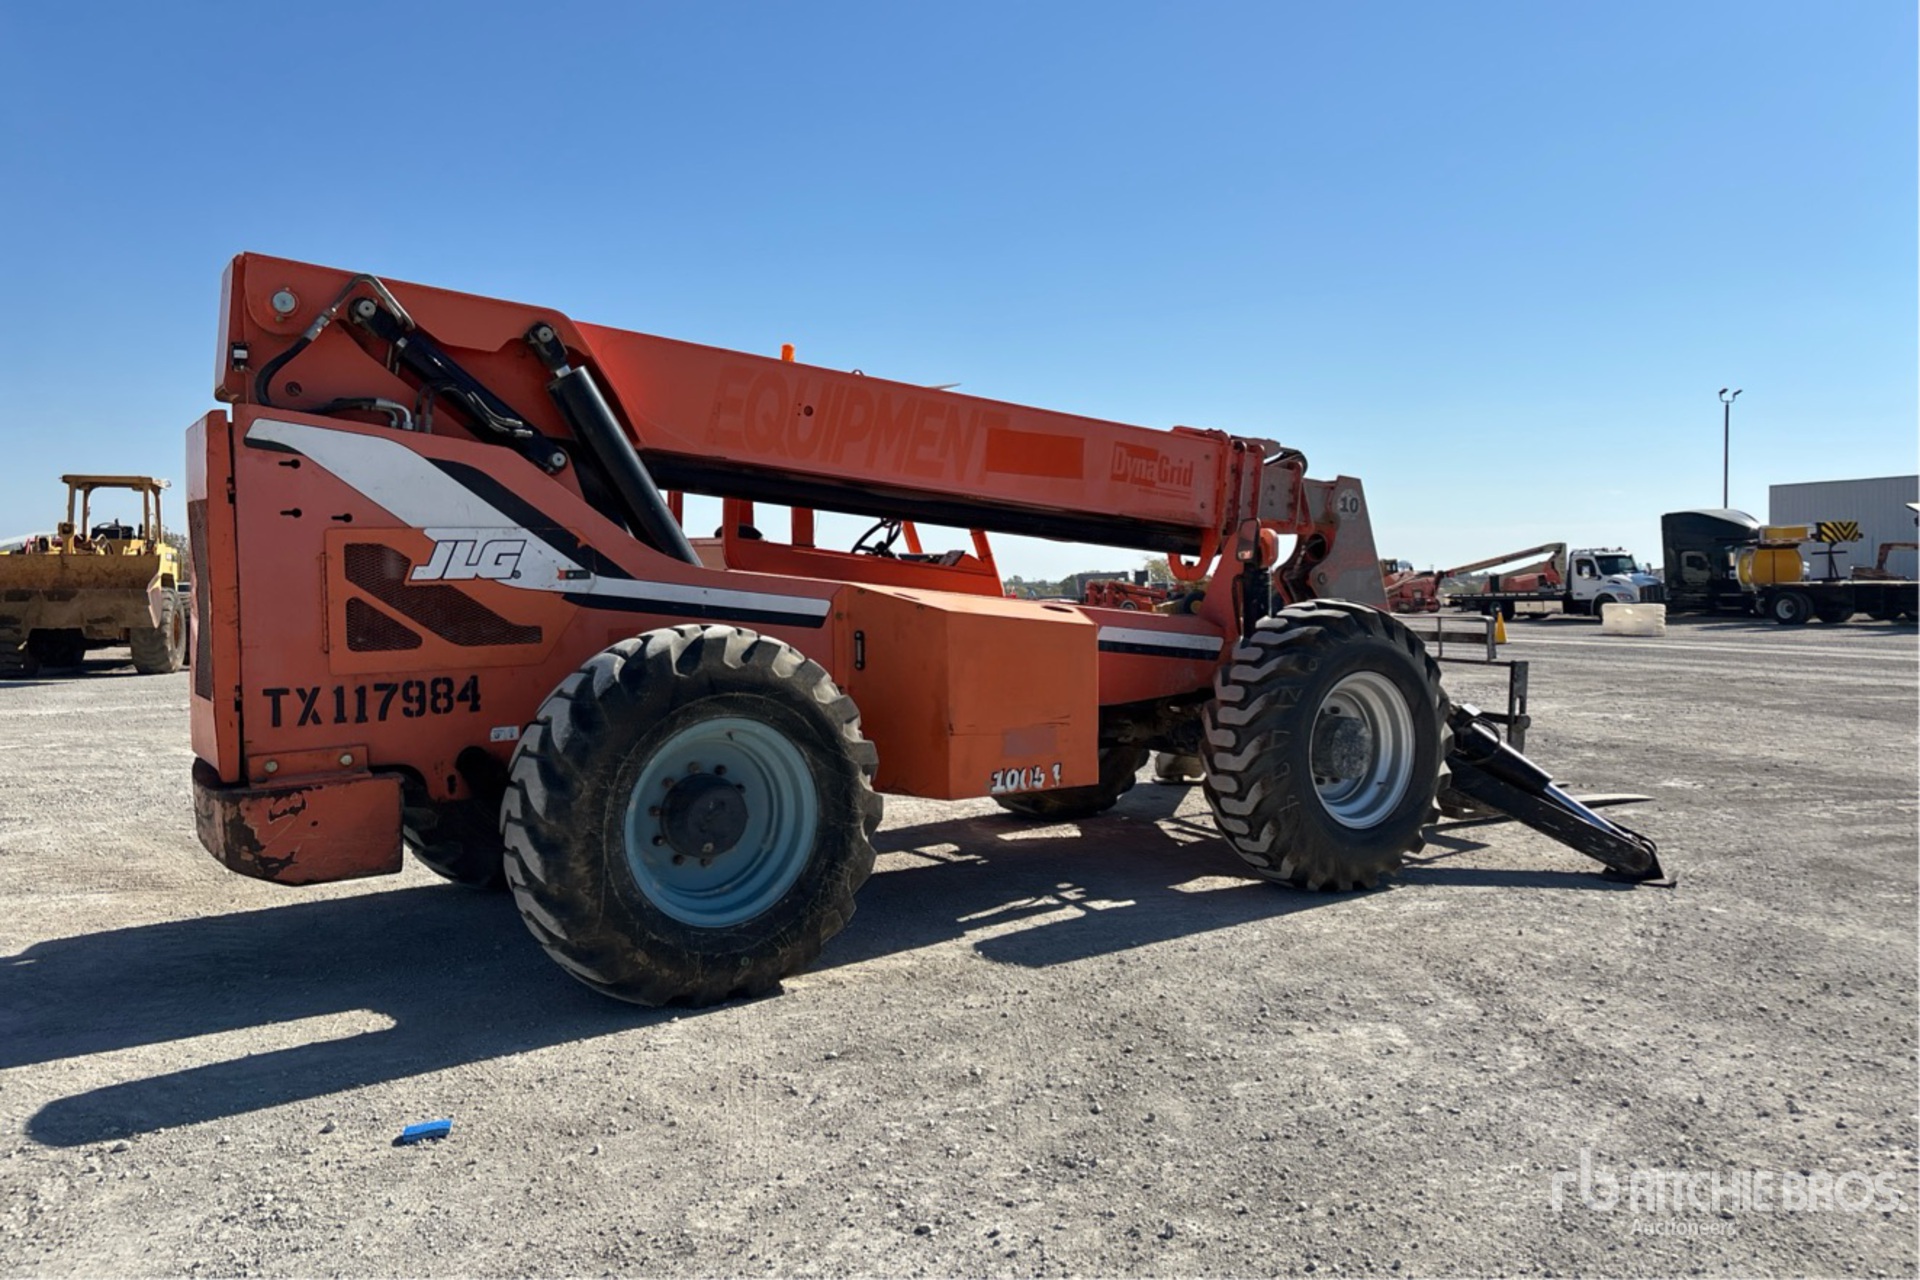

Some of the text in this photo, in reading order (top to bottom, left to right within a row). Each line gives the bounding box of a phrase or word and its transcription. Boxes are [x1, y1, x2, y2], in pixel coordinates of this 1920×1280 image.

[705, 366, 1010, 486] EQUIPMENT
[1112, 445, 1194, 488] DynaGrid
[1340, 496, 1359, 514] 10
[410, 540, 527, 580] JLG
